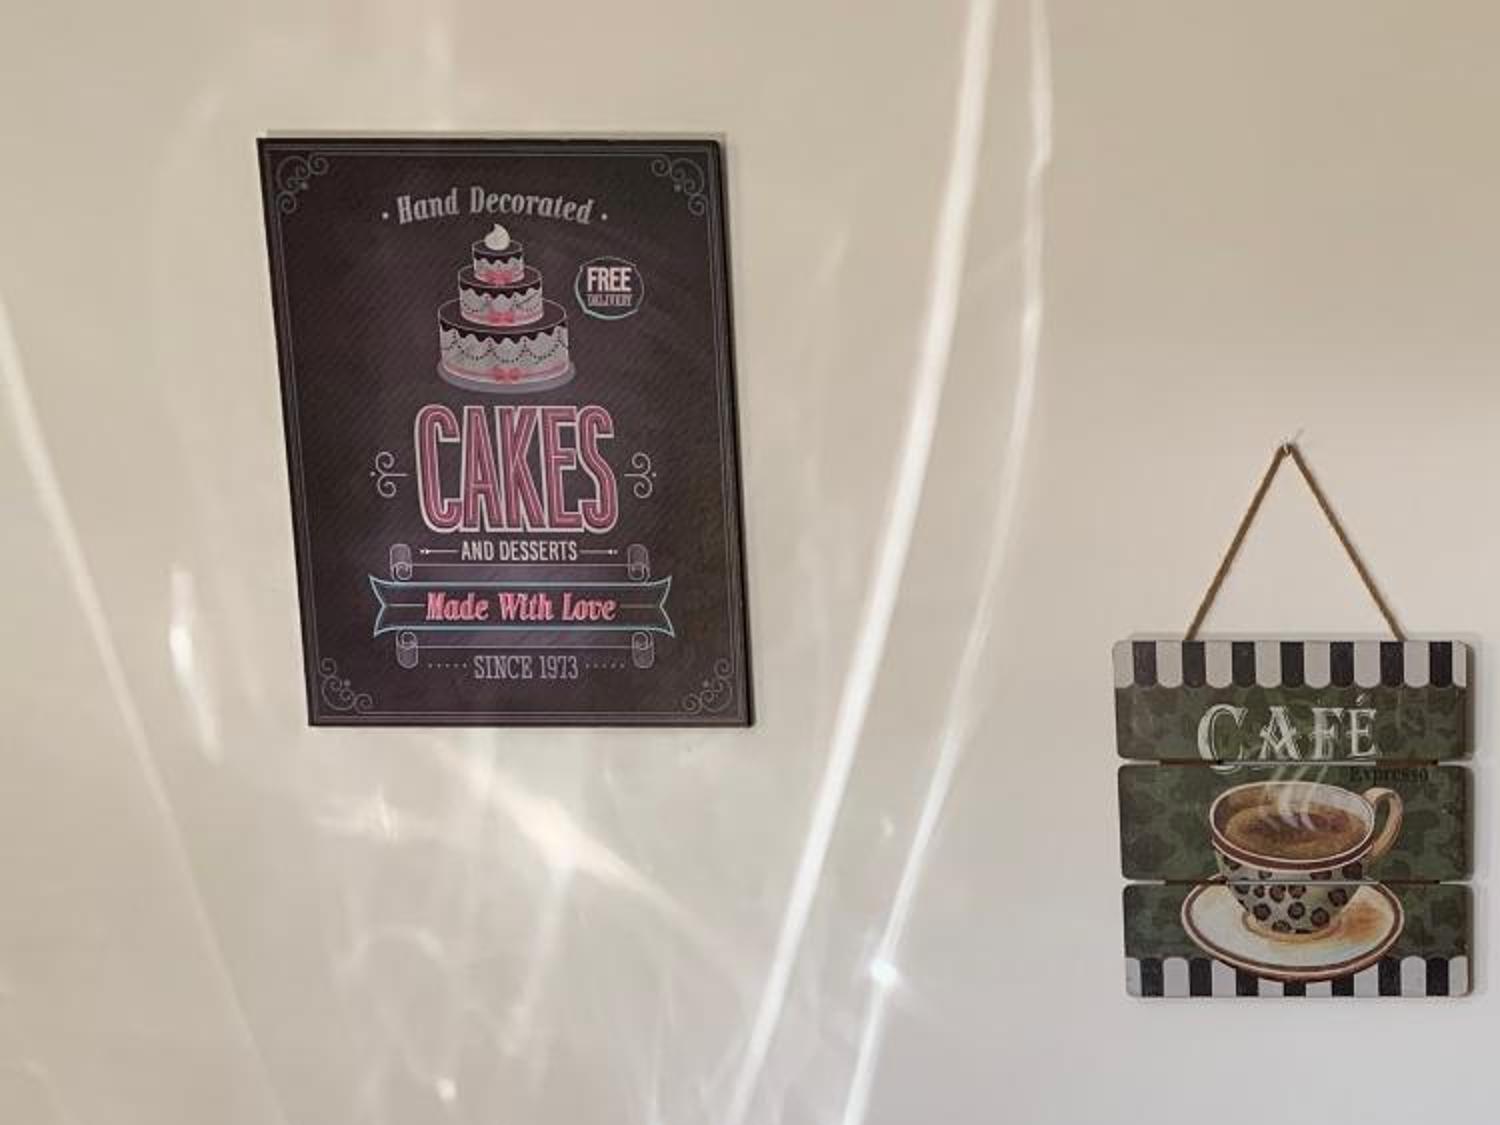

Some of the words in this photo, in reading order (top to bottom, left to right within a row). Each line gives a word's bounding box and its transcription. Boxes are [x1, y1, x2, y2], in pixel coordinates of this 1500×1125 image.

[397, 187, 460, 225] Hand
[470, 186, 595, 225] Decorated
[587, 267, 632, 292] FREE
[414, 403, 619, 534] CAKES
[461, 541, 495, 561] AND
[500, 541, 578, 561] DESSERTS
[425, 592, 489, 621] Made
[498, 592, 555, 621] With
[561, 592, 617, 621] Love
[473, 655, 533, 679] SINCE
[540, 655, 579, 679] 1973
[1197, 692, 1378, 774] CAFÉ
